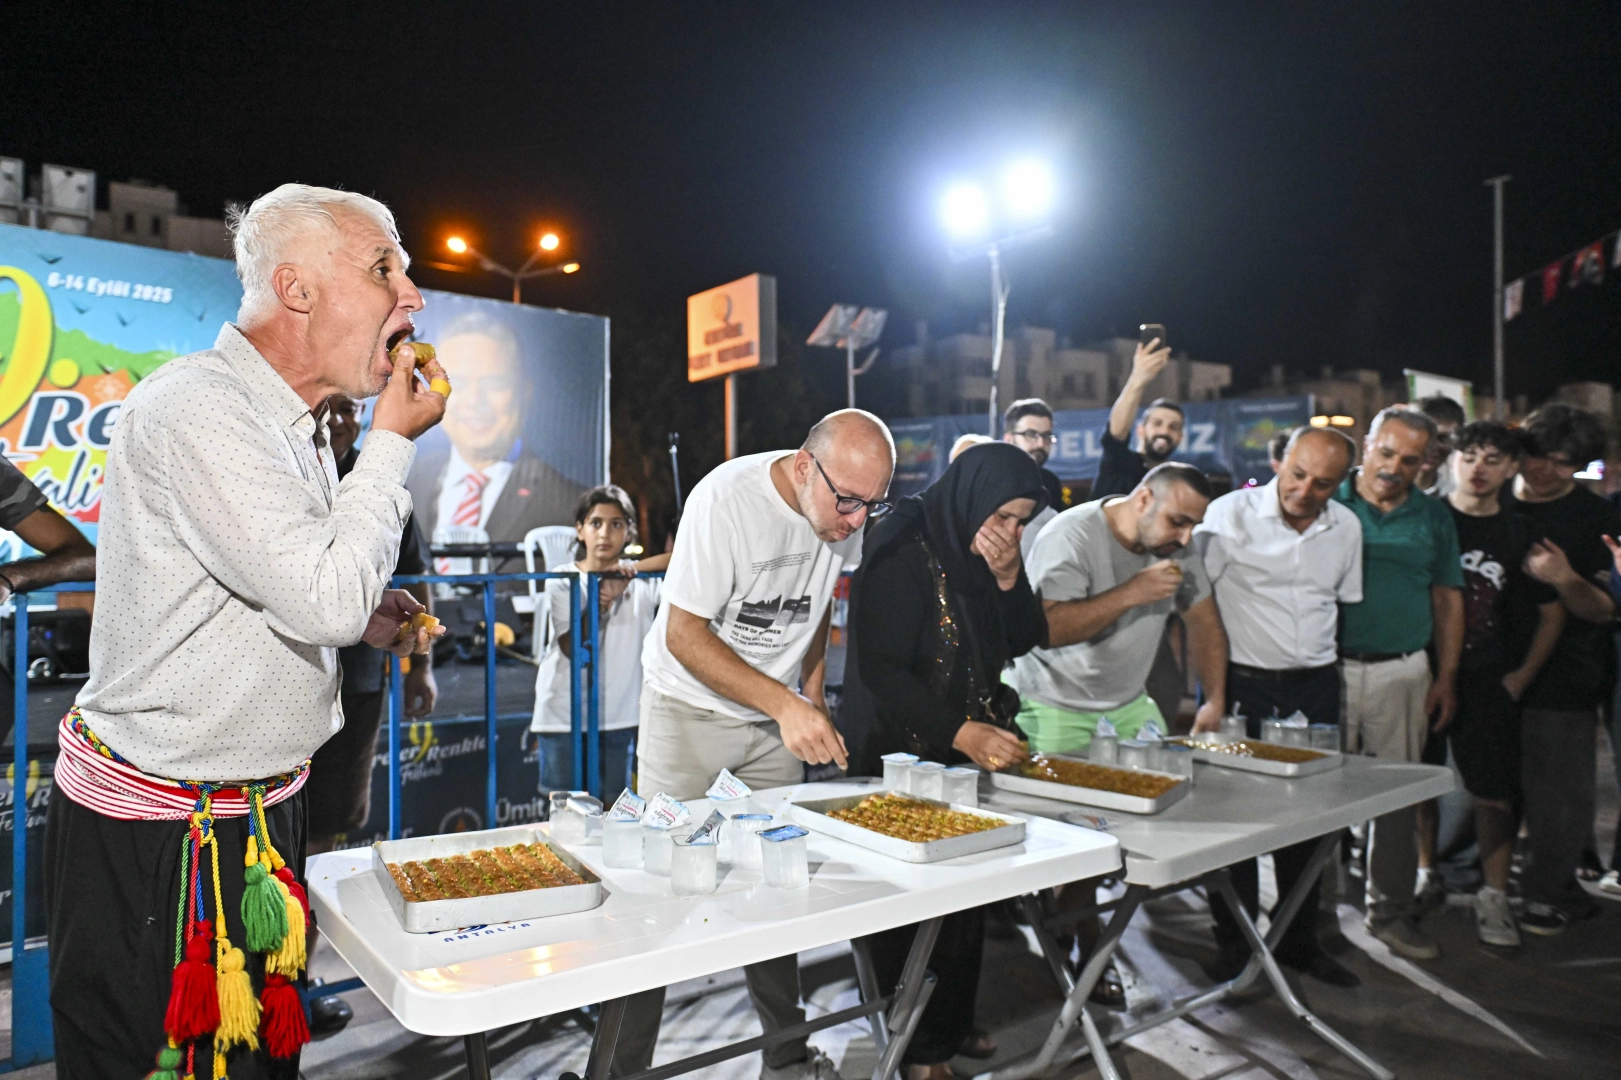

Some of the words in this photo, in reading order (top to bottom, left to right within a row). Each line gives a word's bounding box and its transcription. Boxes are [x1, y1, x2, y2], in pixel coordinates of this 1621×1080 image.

[47, 272, 84, 291] 6-14
[131, 283, 173, 304] 2025
[443, 922, 531, 943] ANTALYA
